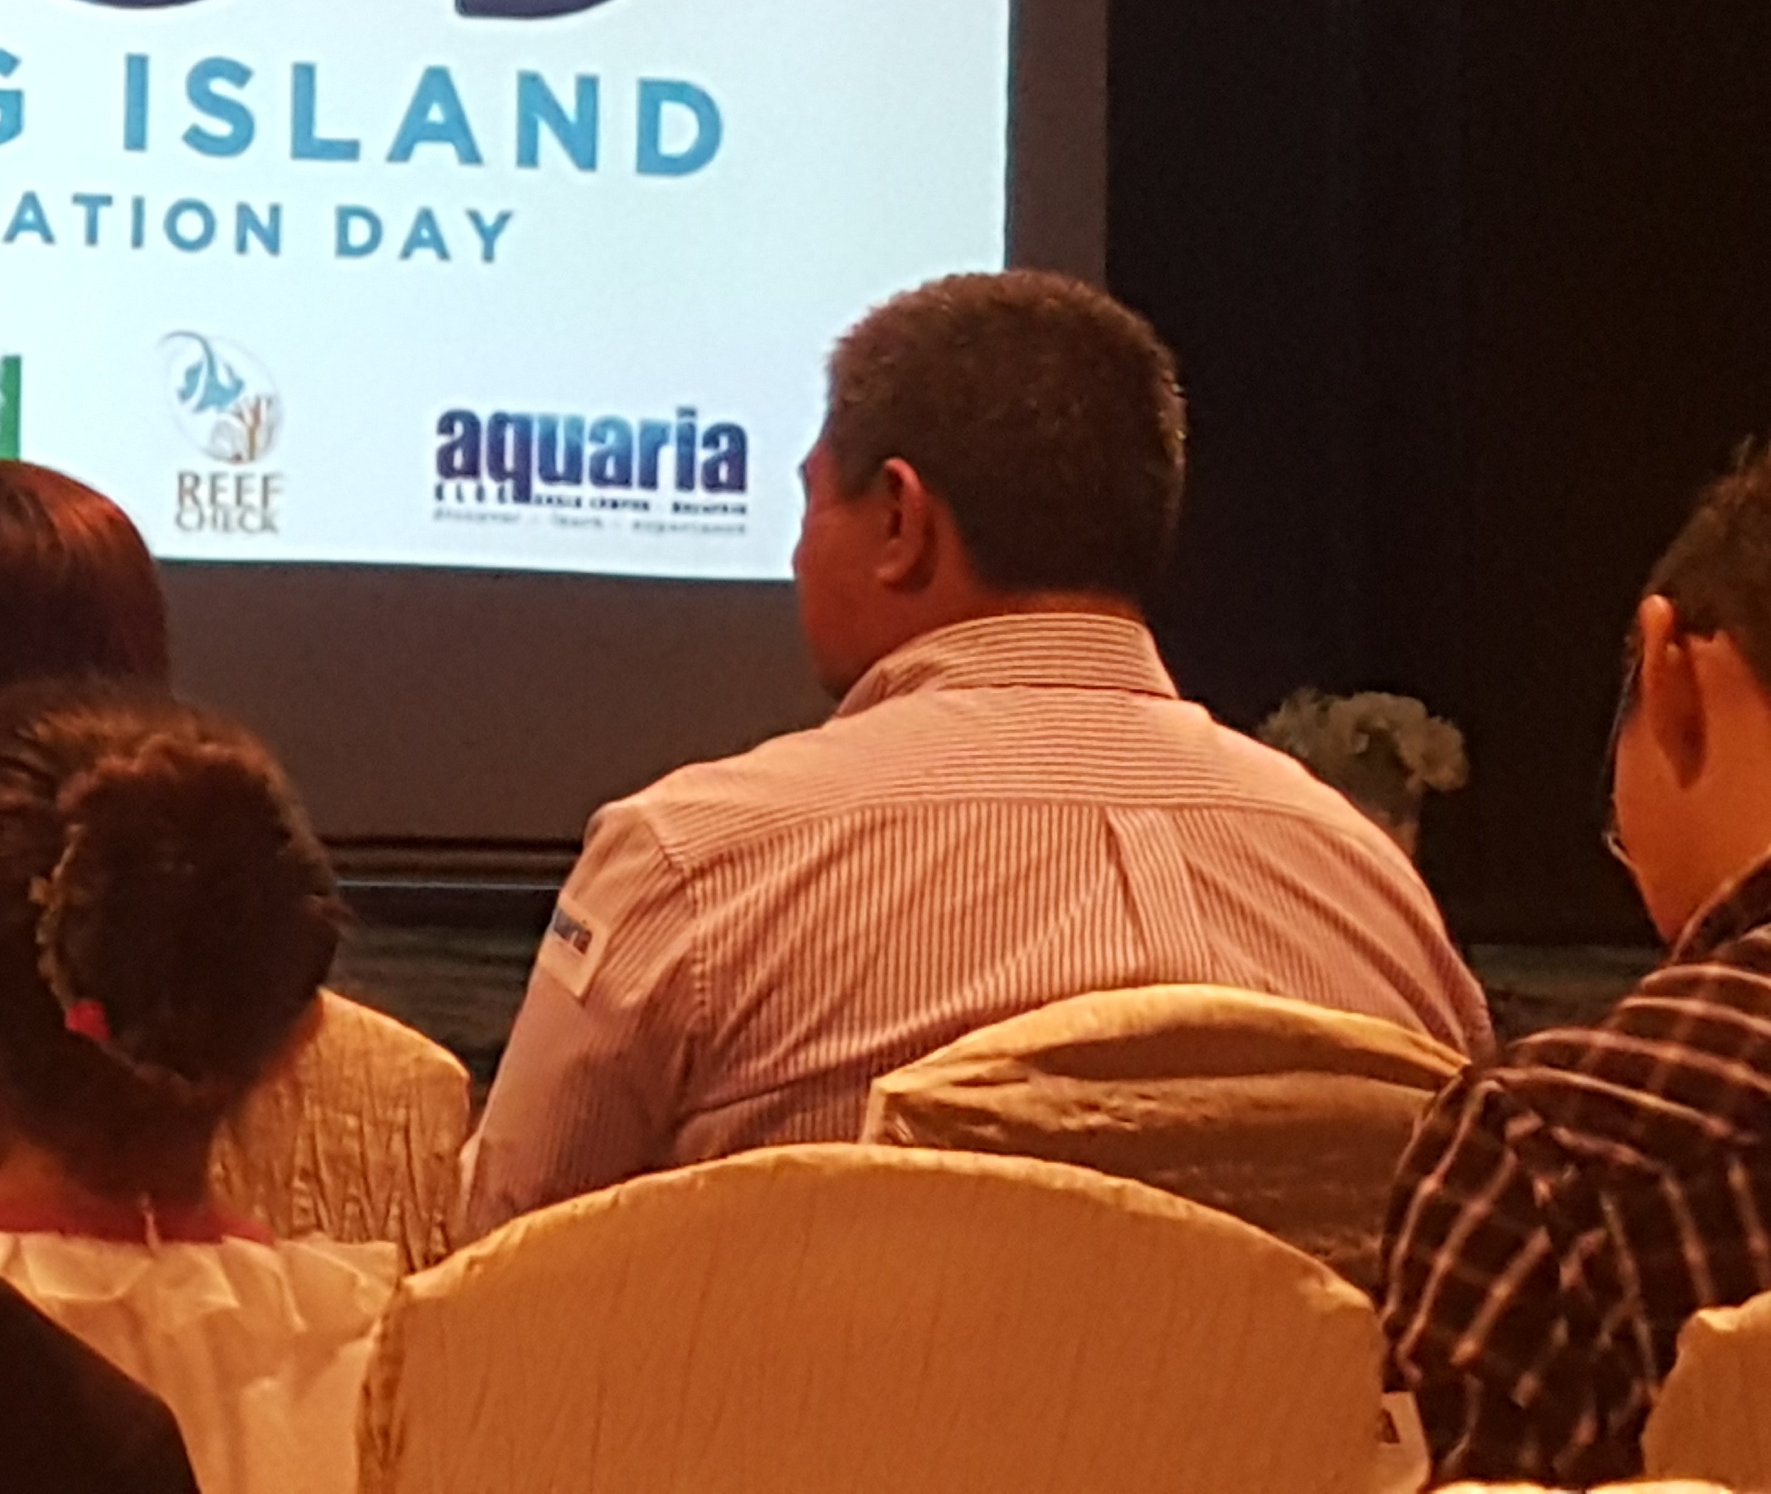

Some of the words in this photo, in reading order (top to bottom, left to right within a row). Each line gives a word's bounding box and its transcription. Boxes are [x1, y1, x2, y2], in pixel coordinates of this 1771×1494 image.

[122, 52, 725, 179] ISLAND
[334, 203, 515, 265] DAY
[175, 469, 285, 508] REEF
[434, 404, 750, 506] aquaria
